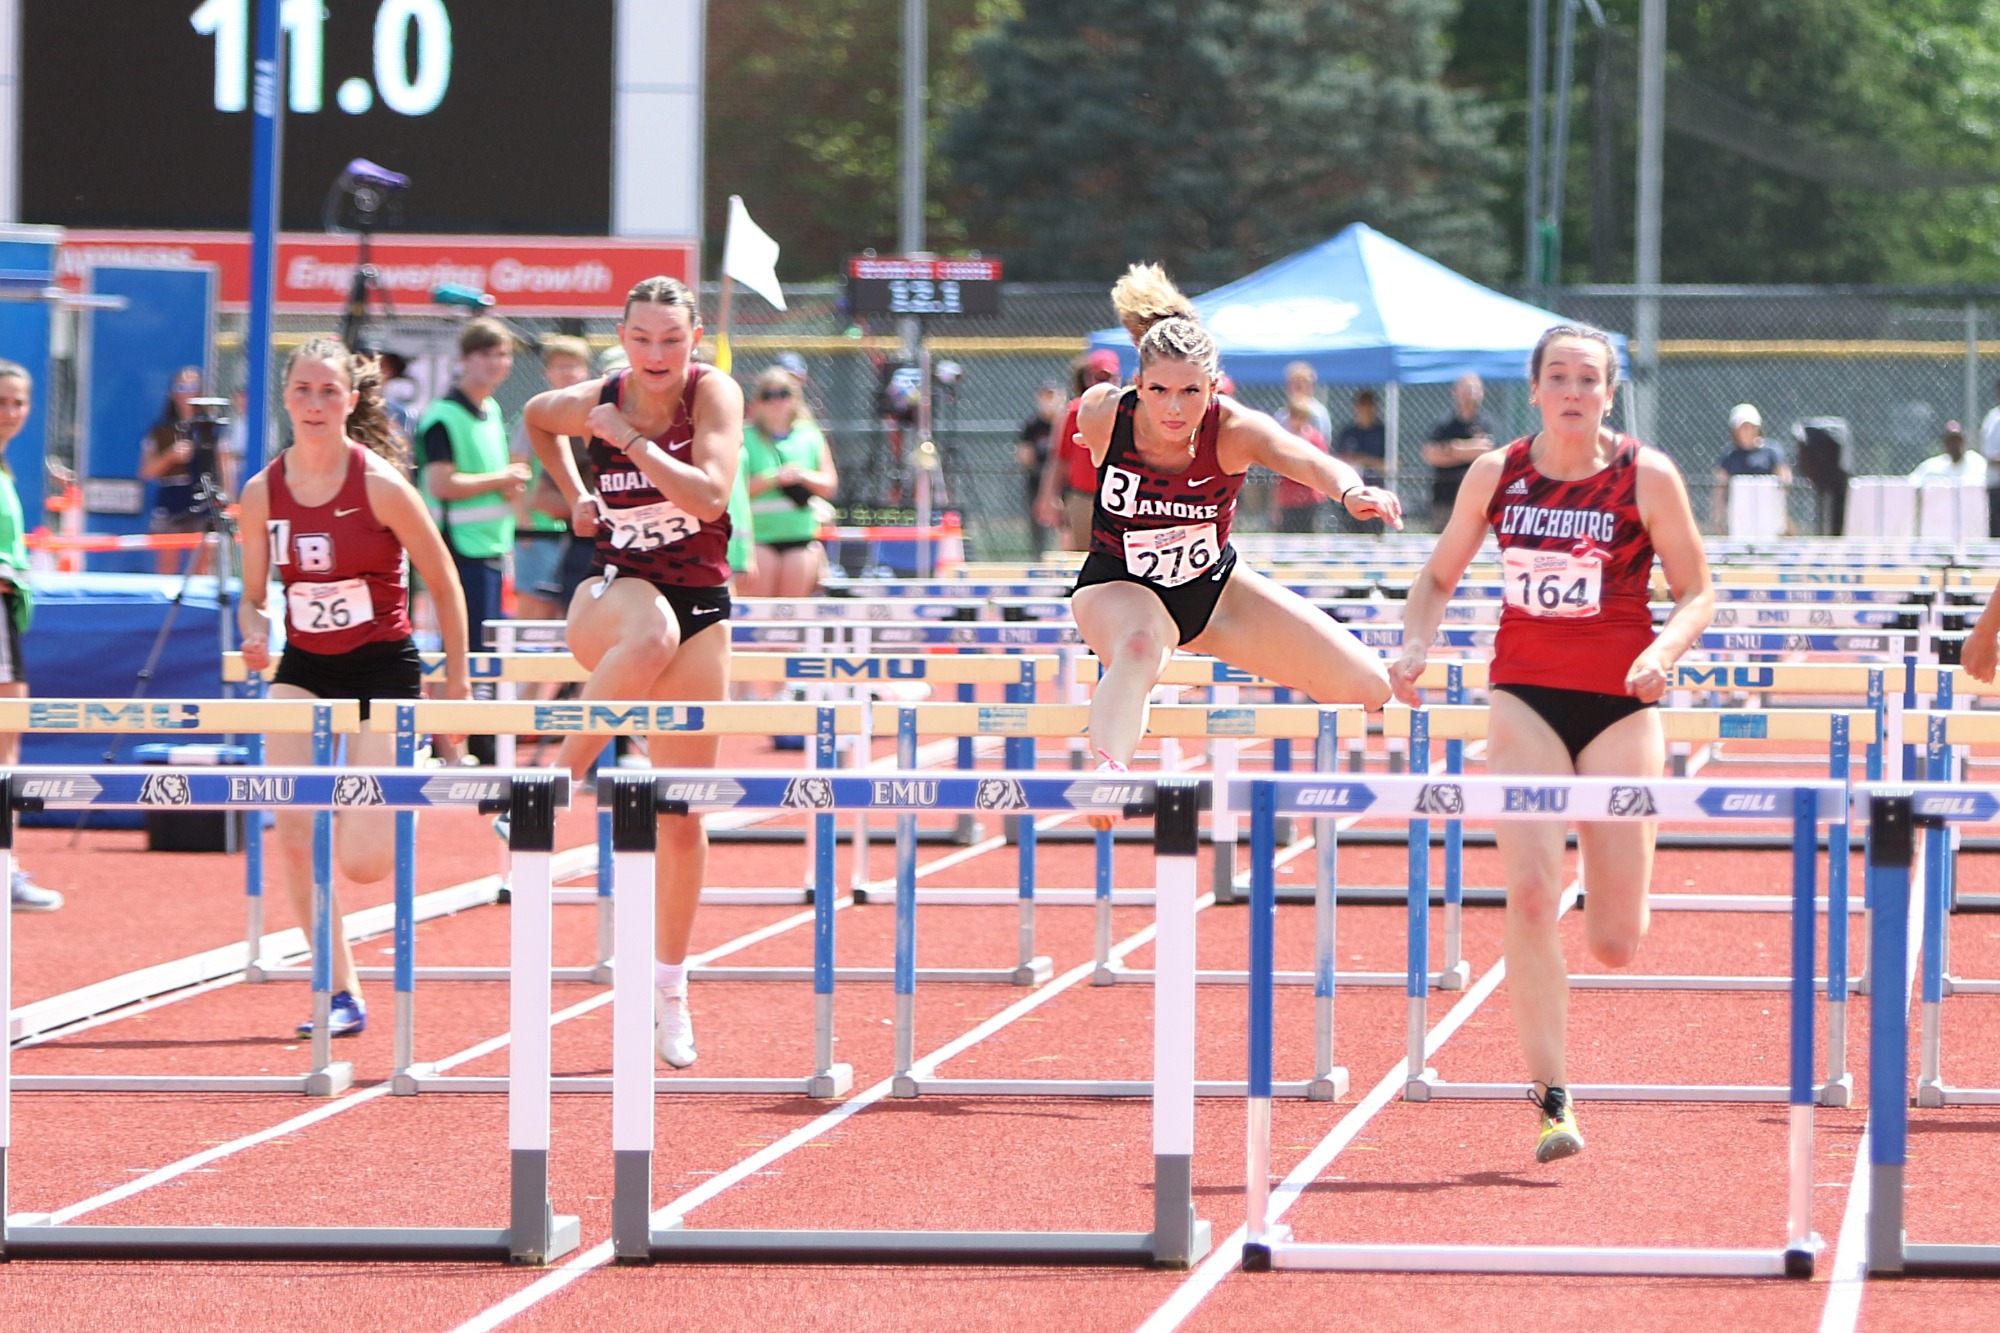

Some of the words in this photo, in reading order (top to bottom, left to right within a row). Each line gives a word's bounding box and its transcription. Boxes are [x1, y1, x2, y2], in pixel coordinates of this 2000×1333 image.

[189, 0, 452, 115] 11.0
[490, 258, 612, 292] Growth
[888, 280, 963, 313] 12.1
[1107, 472, 1130, 512] 3
[1501, 505, 1615, 543] LYNCHBURG
[294, 533, 336, 574] B
[1137, 538, 1210, 581] 276
[1516, 572, 1589, 609] 164
[309, 598, 351, 629] 26
[1723, 633, 1762, 651] EMU
[785, 658, 926, 679] EMU
[29, 703, 200, 729] EMU
[534, 706, 705, 731] EMU
[22, 780, 76, 798] GILL
[227, 776, 297, 803] EMU
[448, 783, 501, 800] GILL
[665, 783, 718, 801] GILL
[870, 780, 941, 808] EMU
[1091, 787, 1144, 804] GILL
[1297, 789, 1349, 806] GILL
[1501, 786, 1571, 814] EMU
[1723, 794, 1776, 811] GILL
[1924, 797, 1976, 814] GILL
